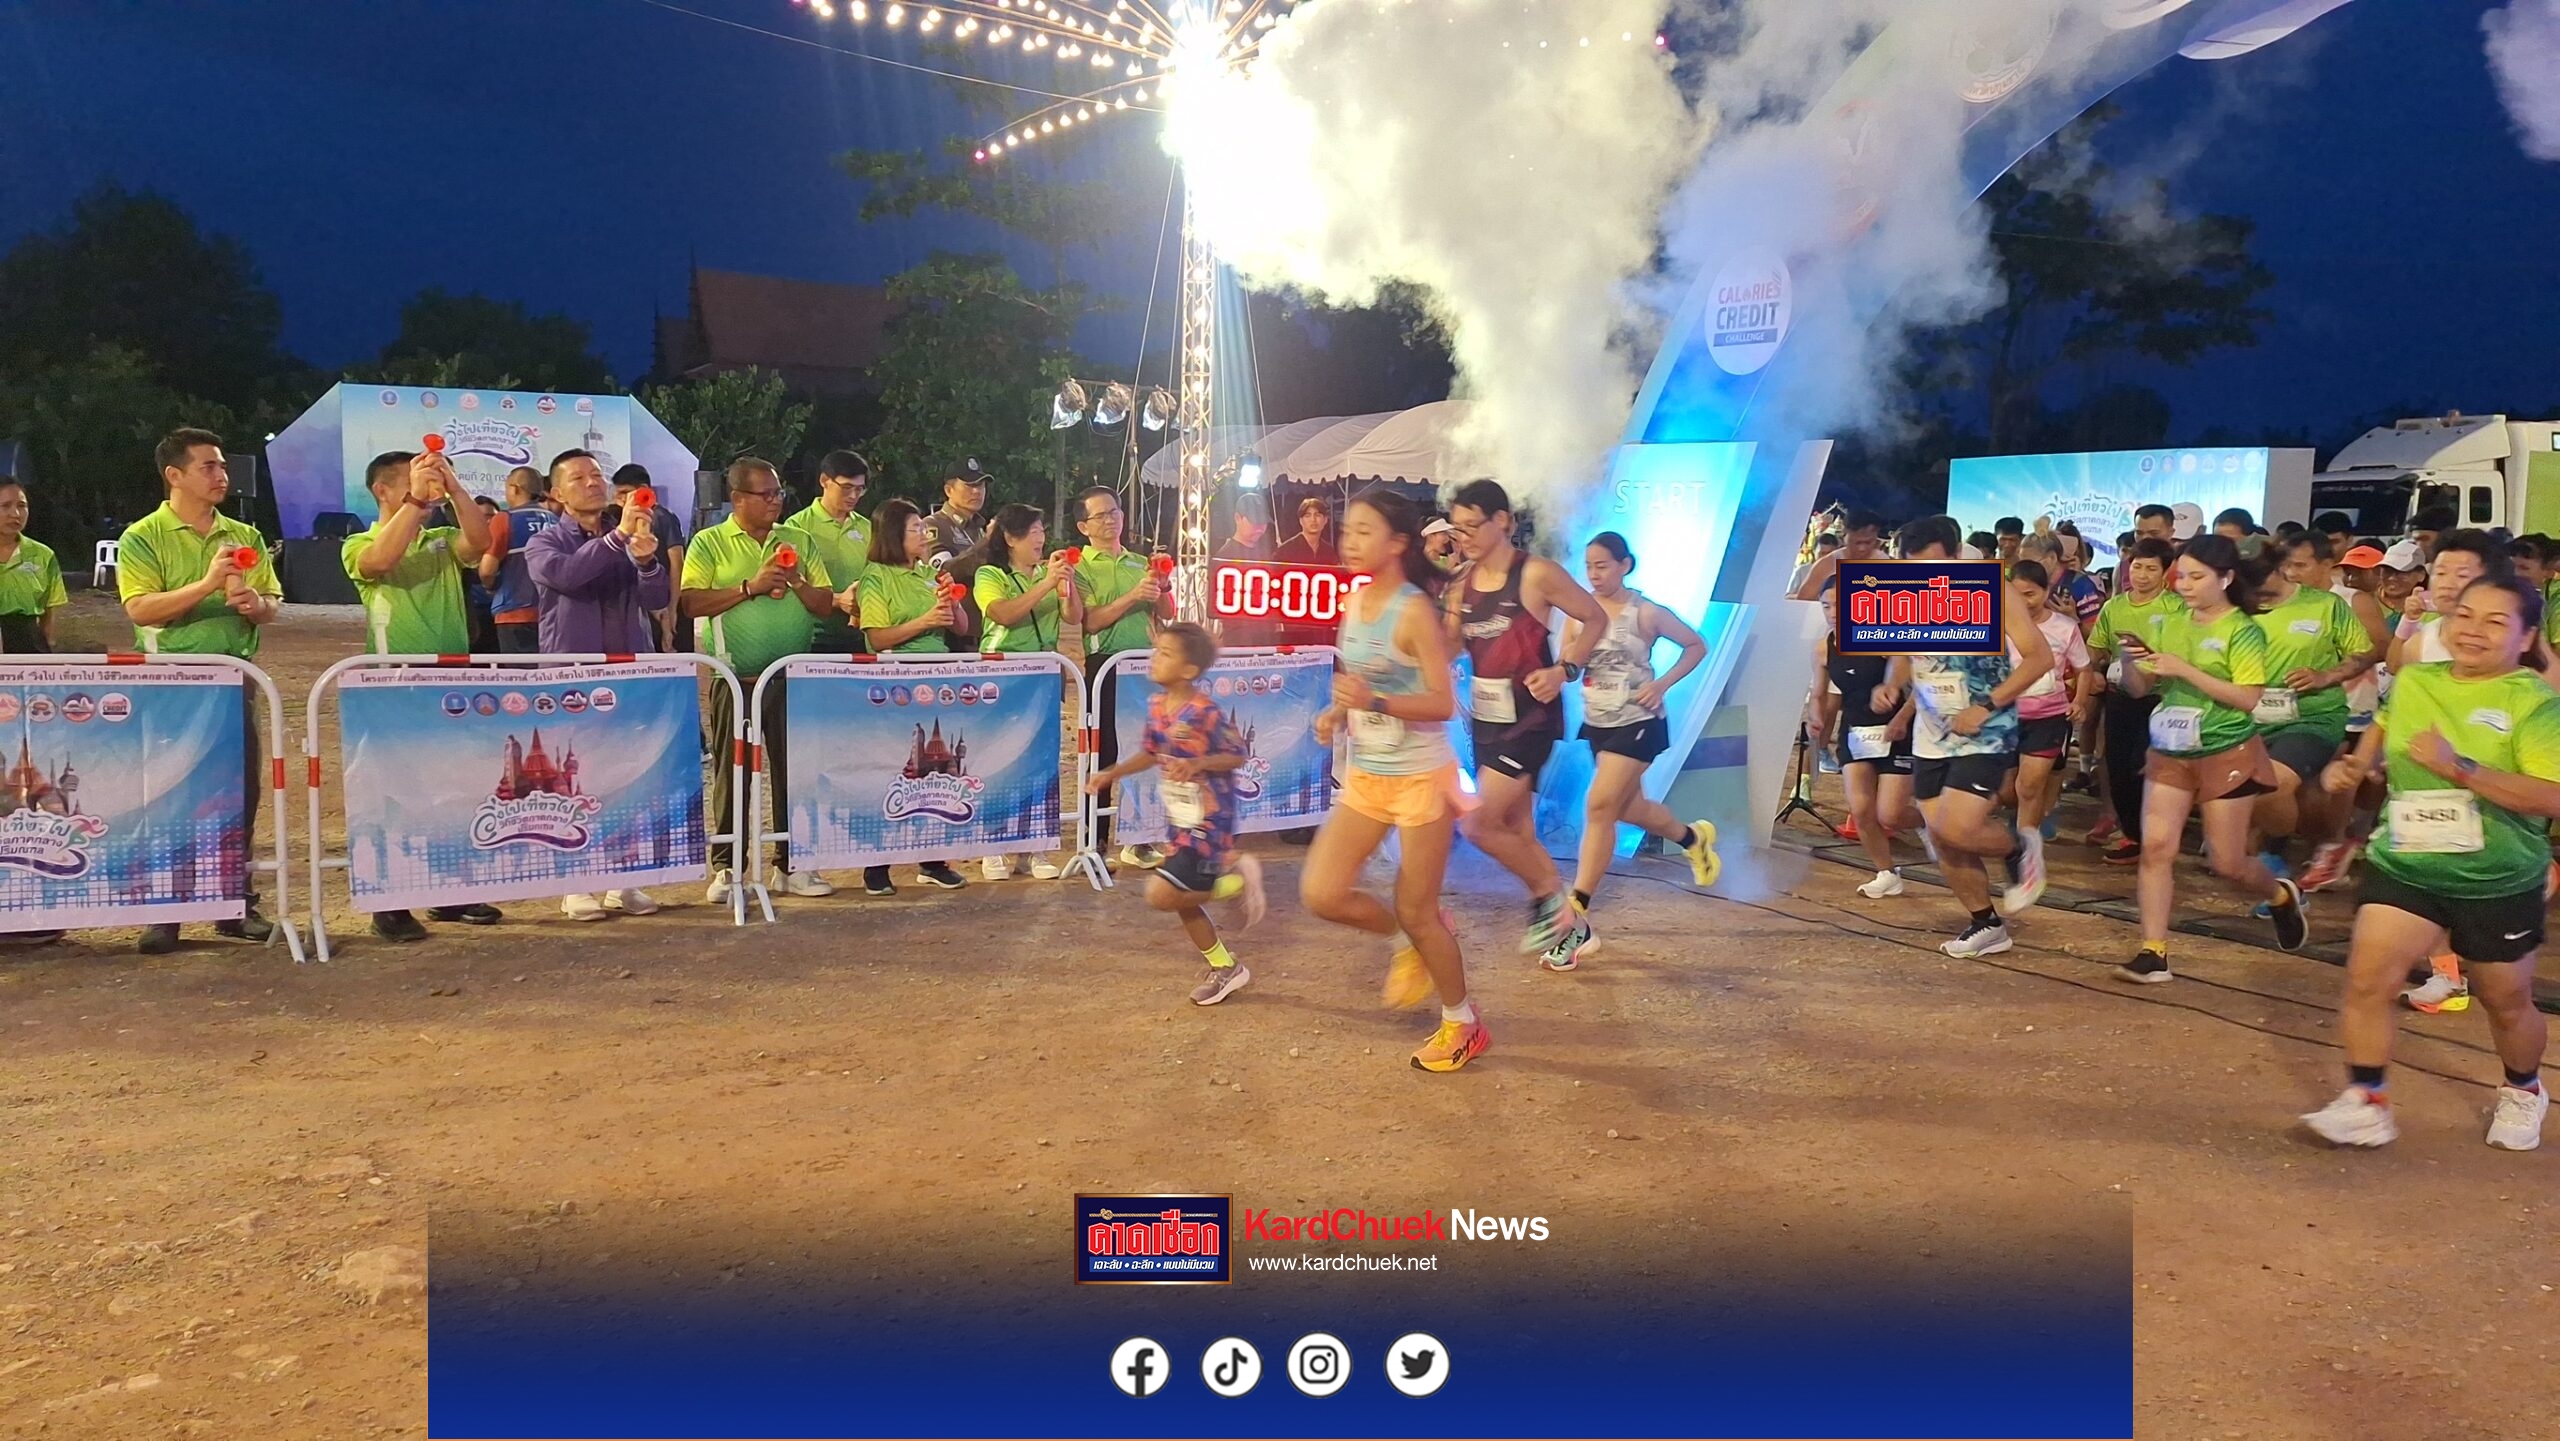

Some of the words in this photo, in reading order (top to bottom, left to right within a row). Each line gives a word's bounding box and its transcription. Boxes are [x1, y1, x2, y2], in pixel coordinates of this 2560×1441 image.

[1716, 302, 1779, 330] CREDIT
[1725, 332, 1765, 343] CHALLENGE
[480, 472, 492, 481] 20
[1613, 480, 1706, 515] START
